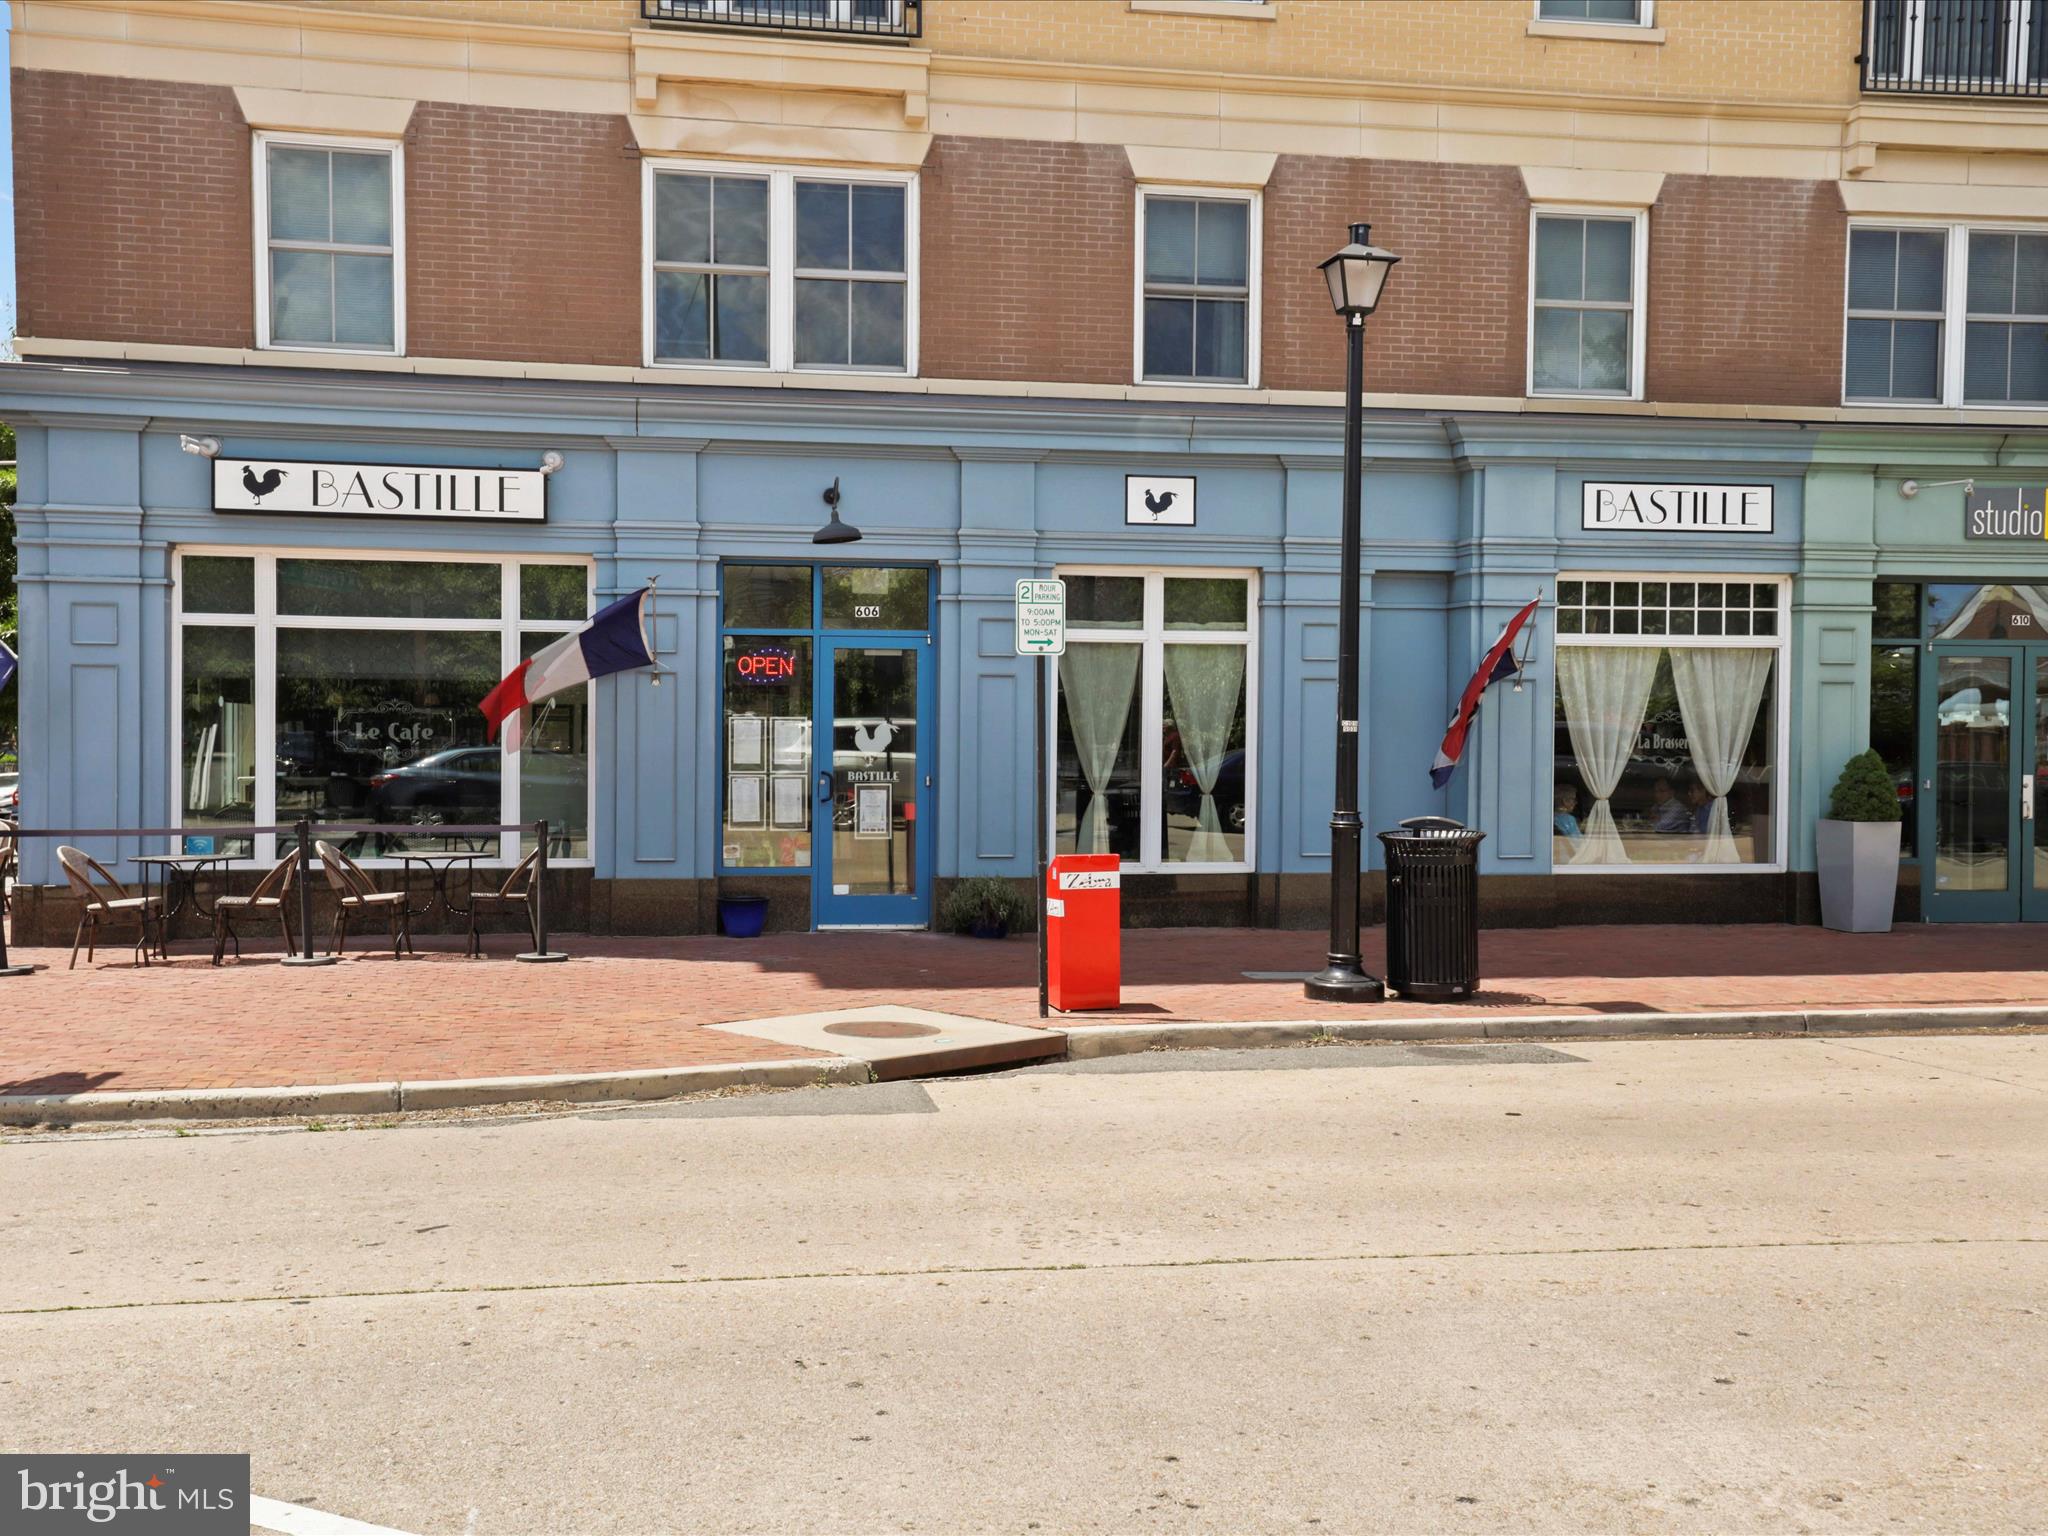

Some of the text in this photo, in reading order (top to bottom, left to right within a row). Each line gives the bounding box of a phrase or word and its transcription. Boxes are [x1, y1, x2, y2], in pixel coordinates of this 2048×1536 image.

[312, 469, 521, 513] BASTILLE
[1596, 489, 1760, 526] BASTILLE
[1972, 487, 2043, 536] studio
[1021, 586, 1030, 599] 2
[1034, 593, 1061, 601] PARKING
[856, 606, 879, 617] 606
[1021, 618, 1031, 626] TO
[2012, 615, 2030, 625] 610
[738, 656, 795, 675] OPEN
[355, 722, 380, 740] Le
[1637, 733, 1651, 749] La
[847, 770, 900, 782] BASTILLE
